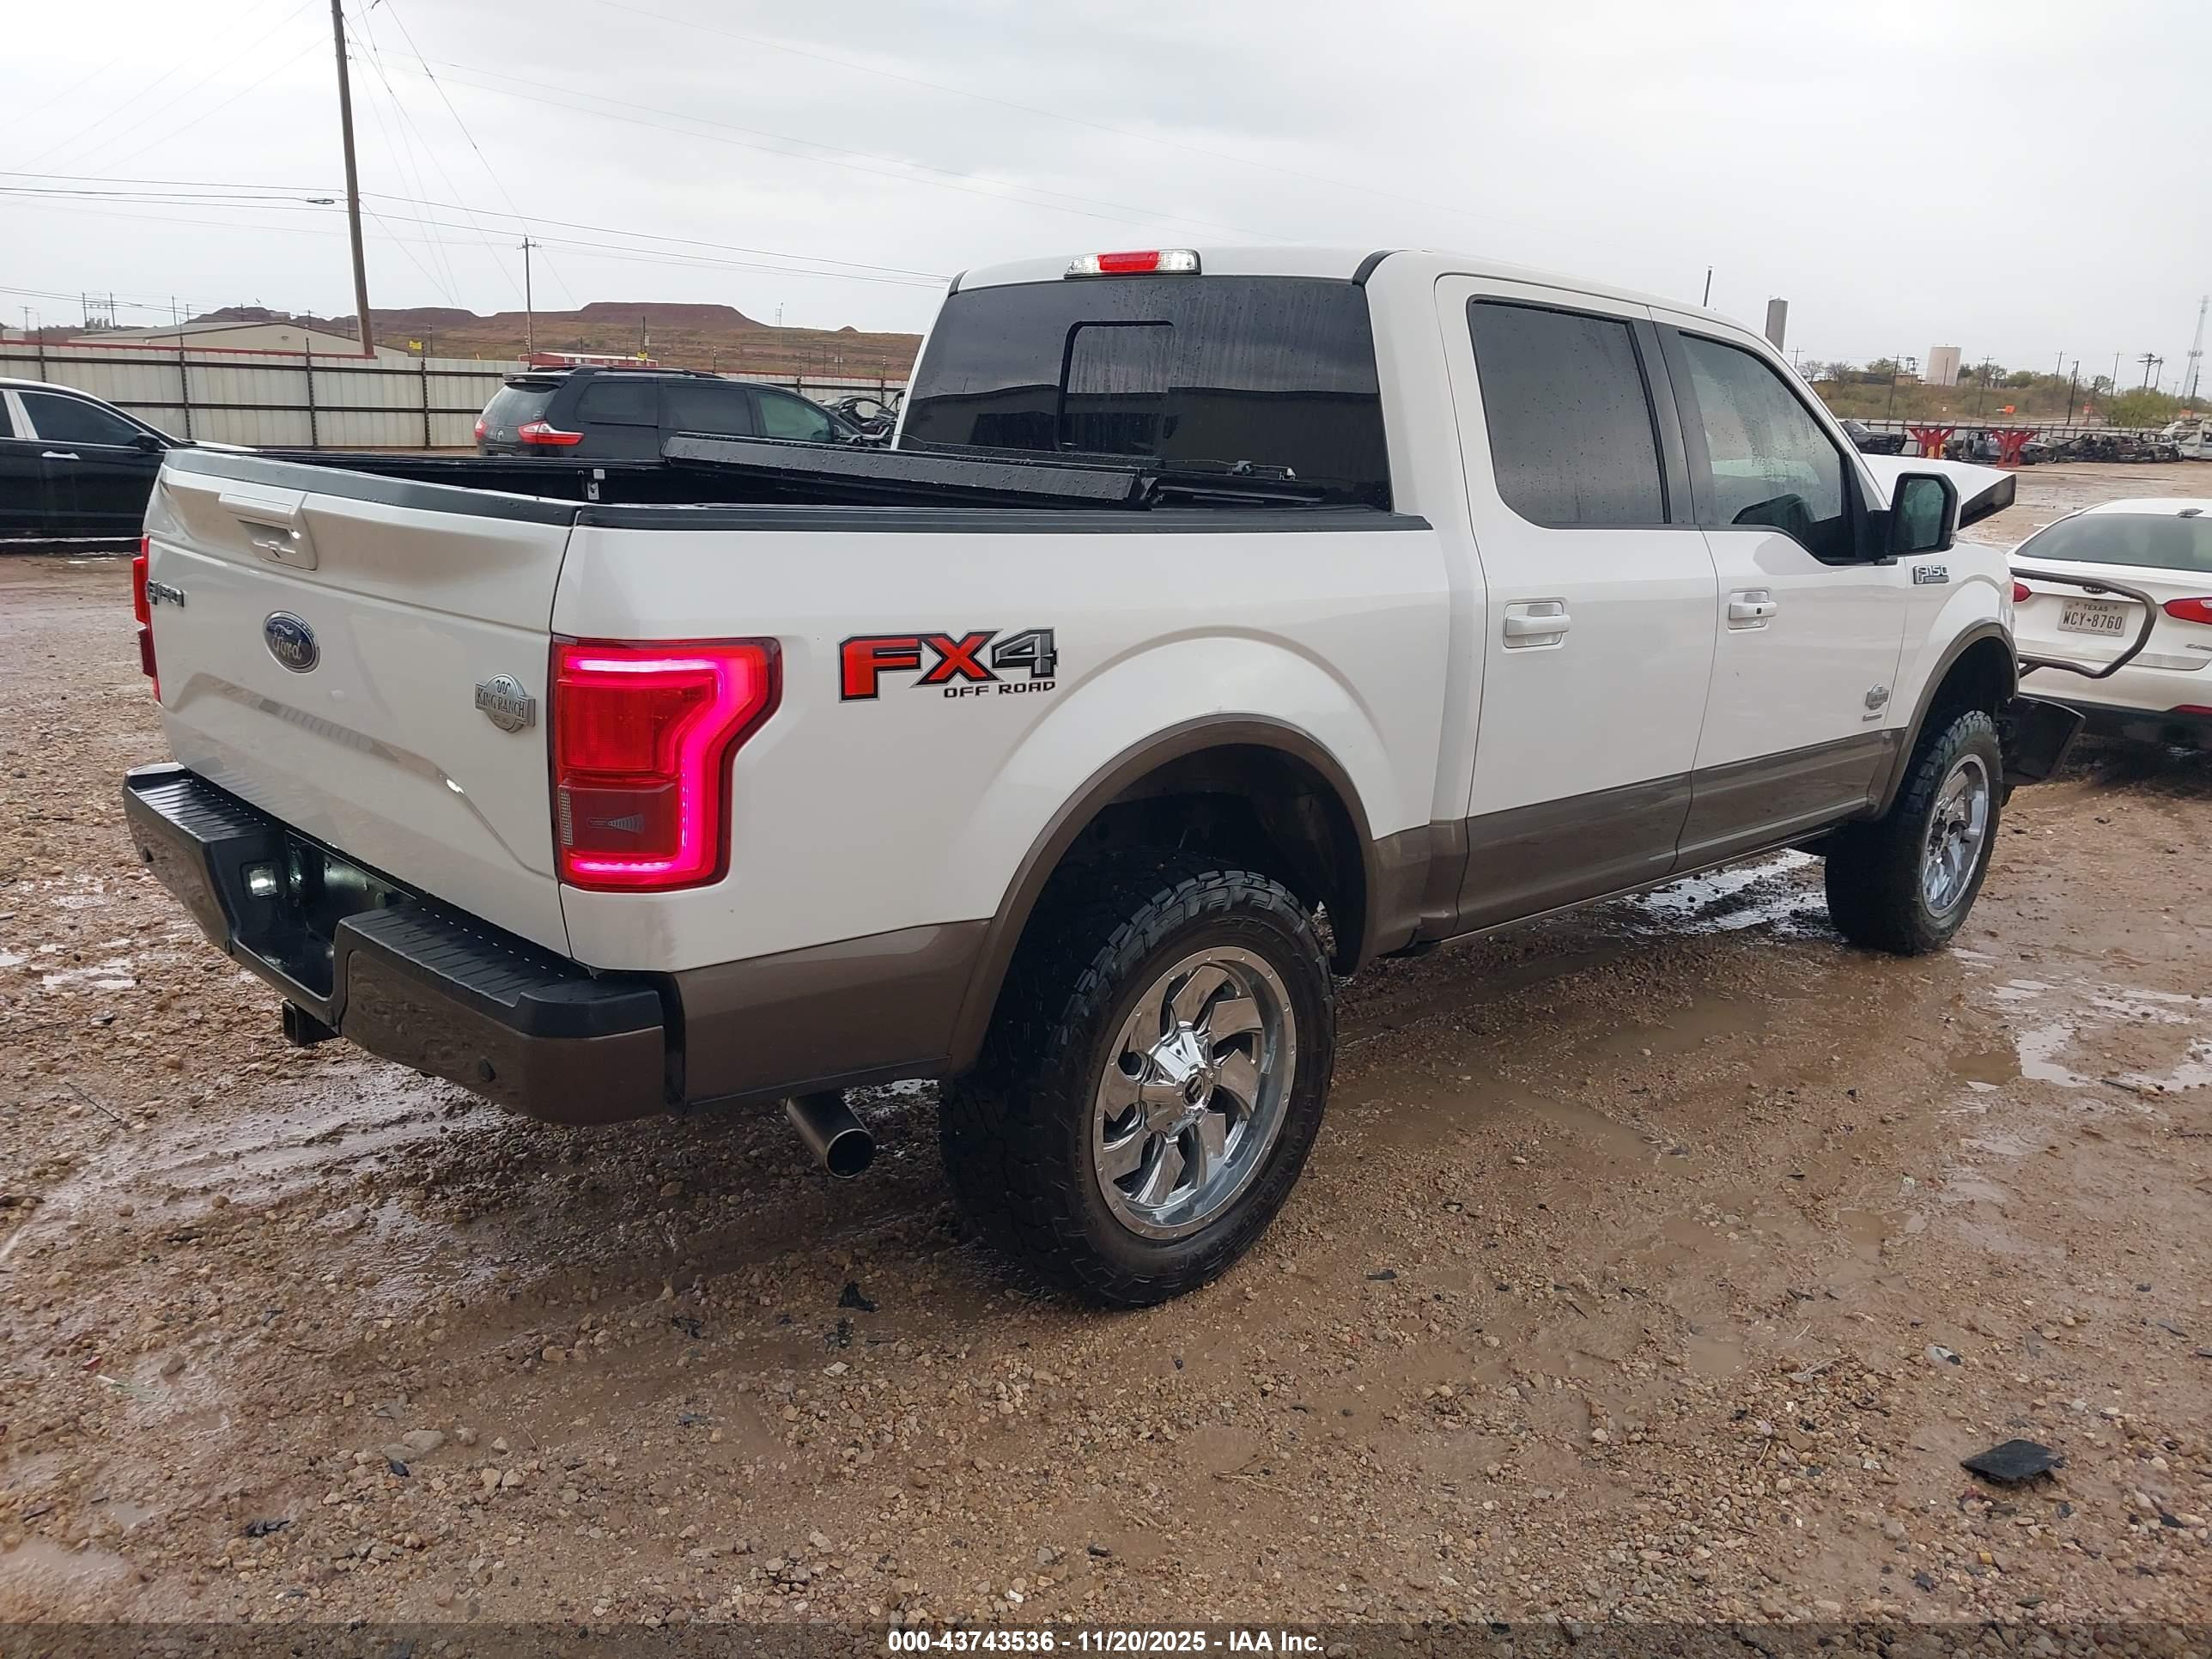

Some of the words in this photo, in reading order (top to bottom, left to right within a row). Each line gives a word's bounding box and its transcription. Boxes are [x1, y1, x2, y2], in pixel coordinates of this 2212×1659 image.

[2084, 604, 2108, 612] TEXAS
[272, 624, 302, 659] Ford
[839, 628, 1057, 702] FX4
[477, 687, 496, 709] KING
[497, 696, 525, 719] RANCH
[944, 685, 989, 698] OFF
[999, 681, 1055, 695] ROAD
